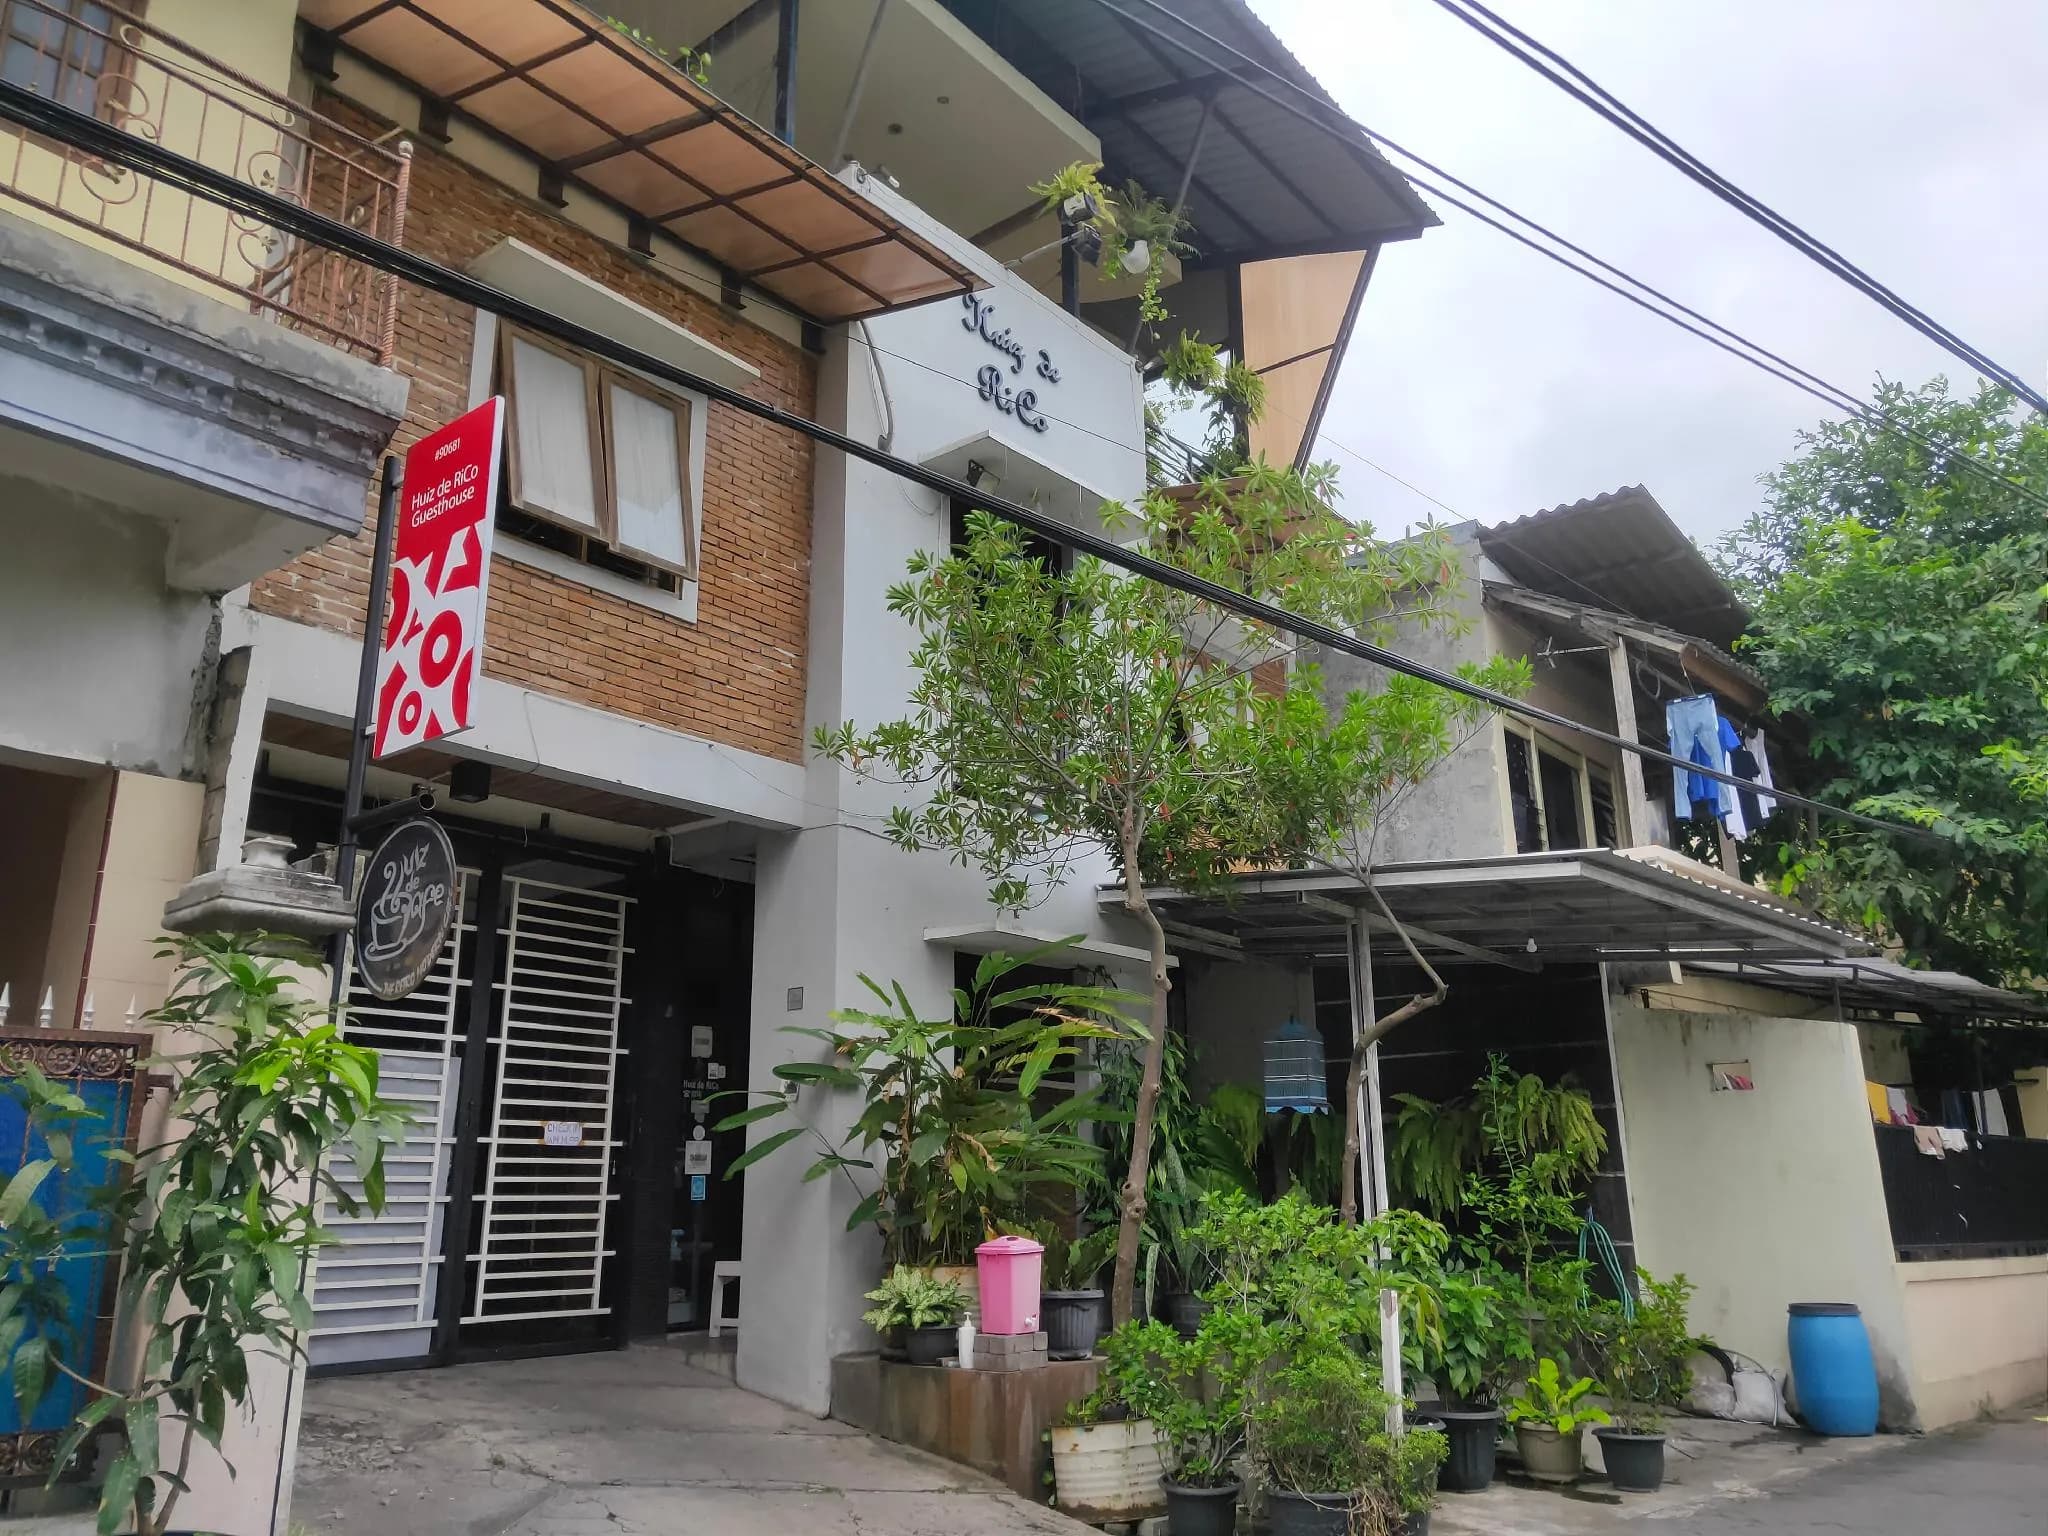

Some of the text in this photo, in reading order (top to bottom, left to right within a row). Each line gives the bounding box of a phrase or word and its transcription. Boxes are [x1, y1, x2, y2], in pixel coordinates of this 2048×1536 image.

[1036, 349, 1061, 384] de
[977, 364, 1050, 432] RiCo
[411, 463, 479, 511] Huiz de RiCo
[411, 485, 475, 528] Guesthouse
[405, 874, 420, 892] de
